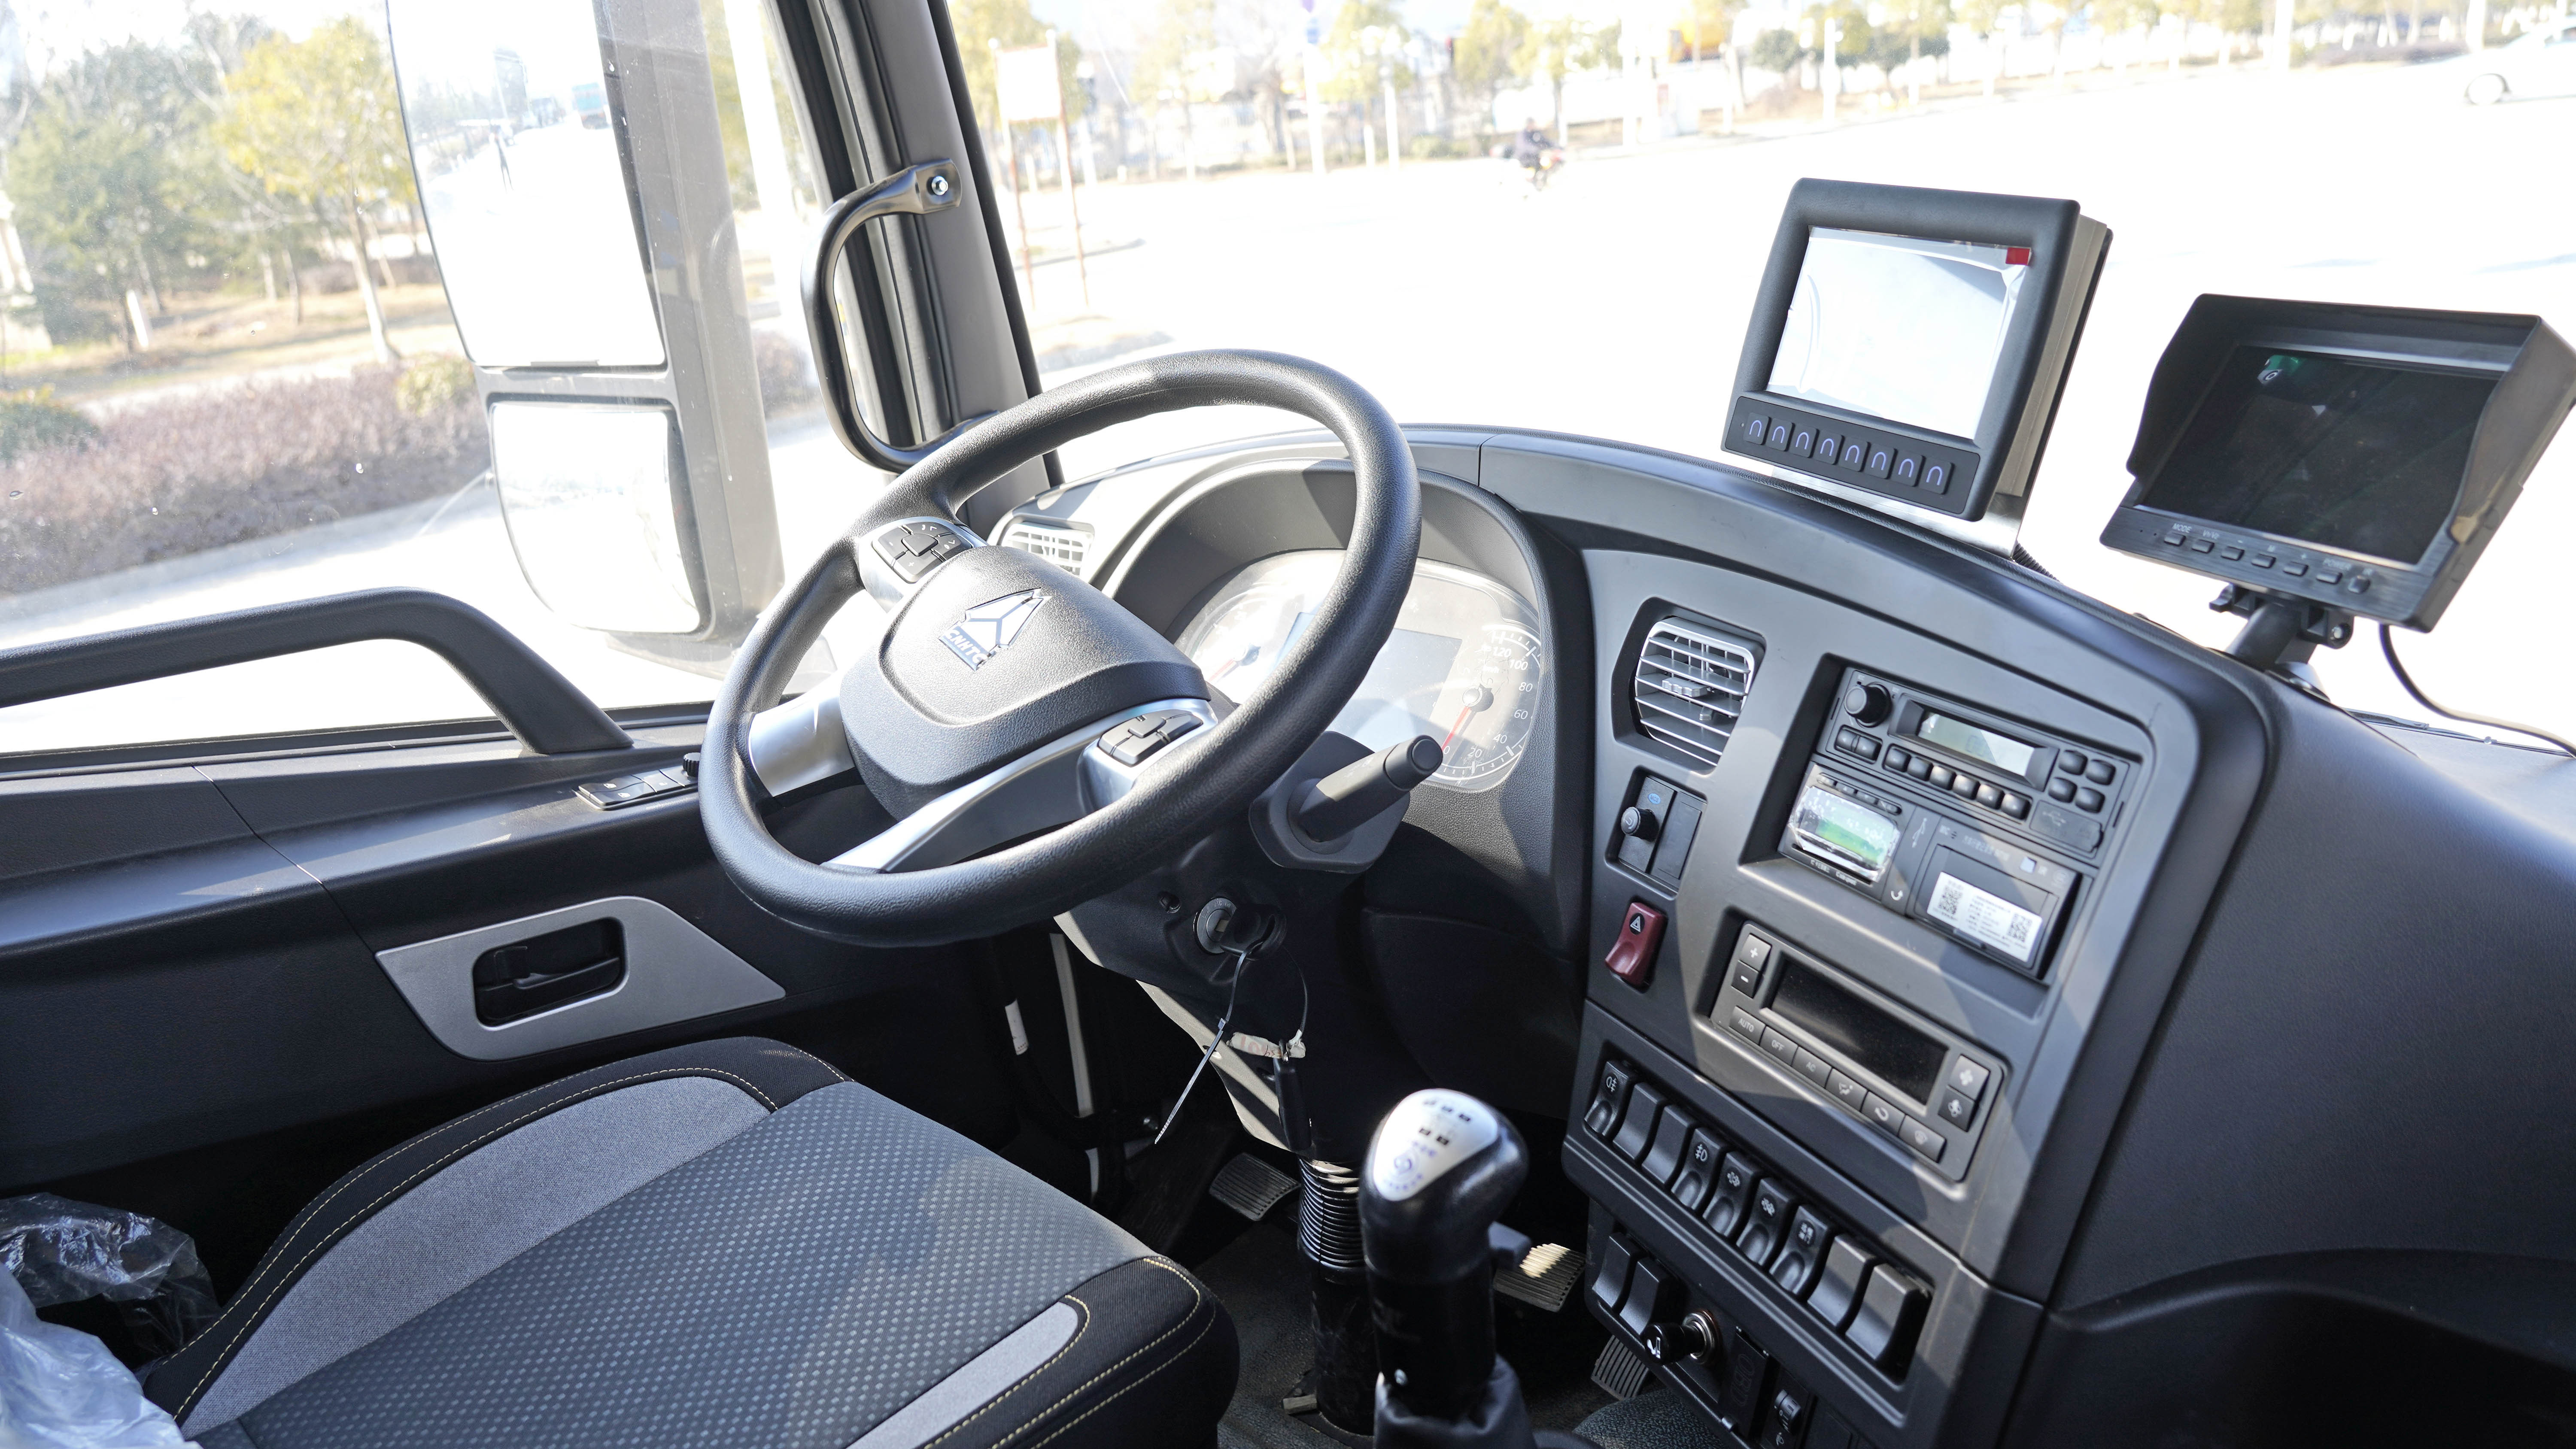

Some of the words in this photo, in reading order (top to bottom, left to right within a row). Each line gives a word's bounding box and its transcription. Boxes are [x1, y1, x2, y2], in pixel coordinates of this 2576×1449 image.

[2172, 523, 2192, 533] MODE
[945, 629, 987, 664] CNHTC
[1492, 646, 1512, 658] 120
[1510, 659, 1529, 670] 100
[1518, 682, 1533, 692] 80
[1514, 709, 1528, 720] 60
[1493, 733, 1508, 744] 40
[1467, 747, 1482, 758] 20
[1738, 1018, 1755, 1033] AUTO
[1771, 1040, 1785, 1051] OFF
